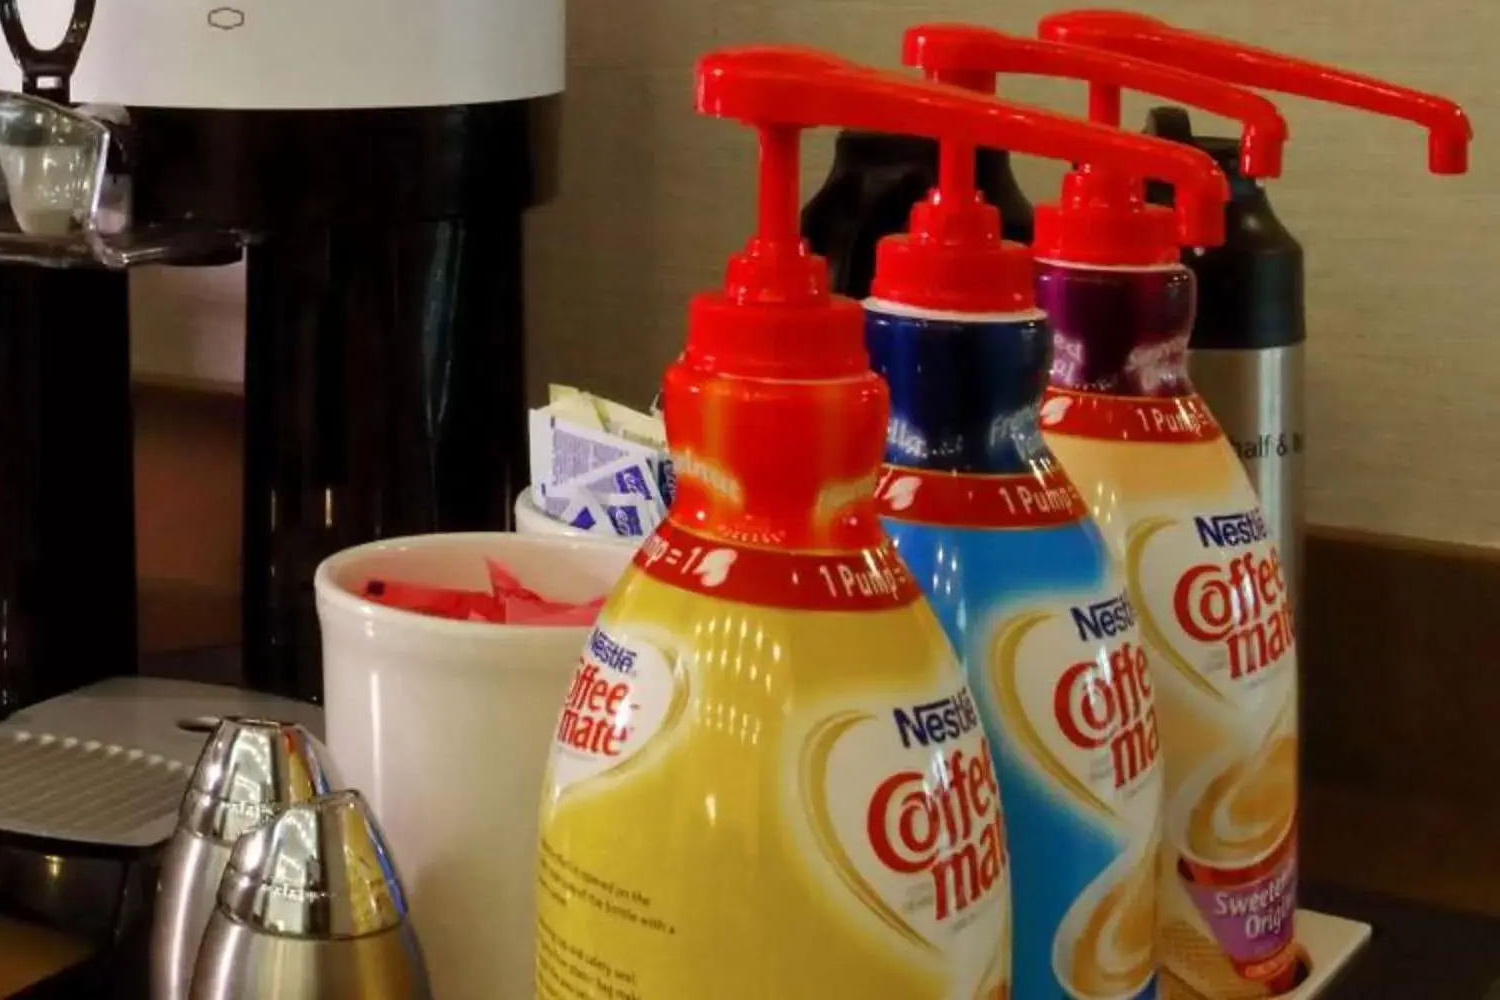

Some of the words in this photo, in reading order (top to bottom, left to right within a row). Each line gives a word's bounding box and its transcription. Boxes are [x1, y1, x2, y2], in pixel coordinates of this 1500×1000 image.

[999, 487, 1016, 515] 1
[819, 565, 836, 597] 1
[1070, 594, 1134, 641] Nest
[1227, 603, 1292, 681] mat
[1054, 641, 1150, 749] Coffe
[557, 708, 628, 756] mate
[1110, 705, 1160, 790] ma
